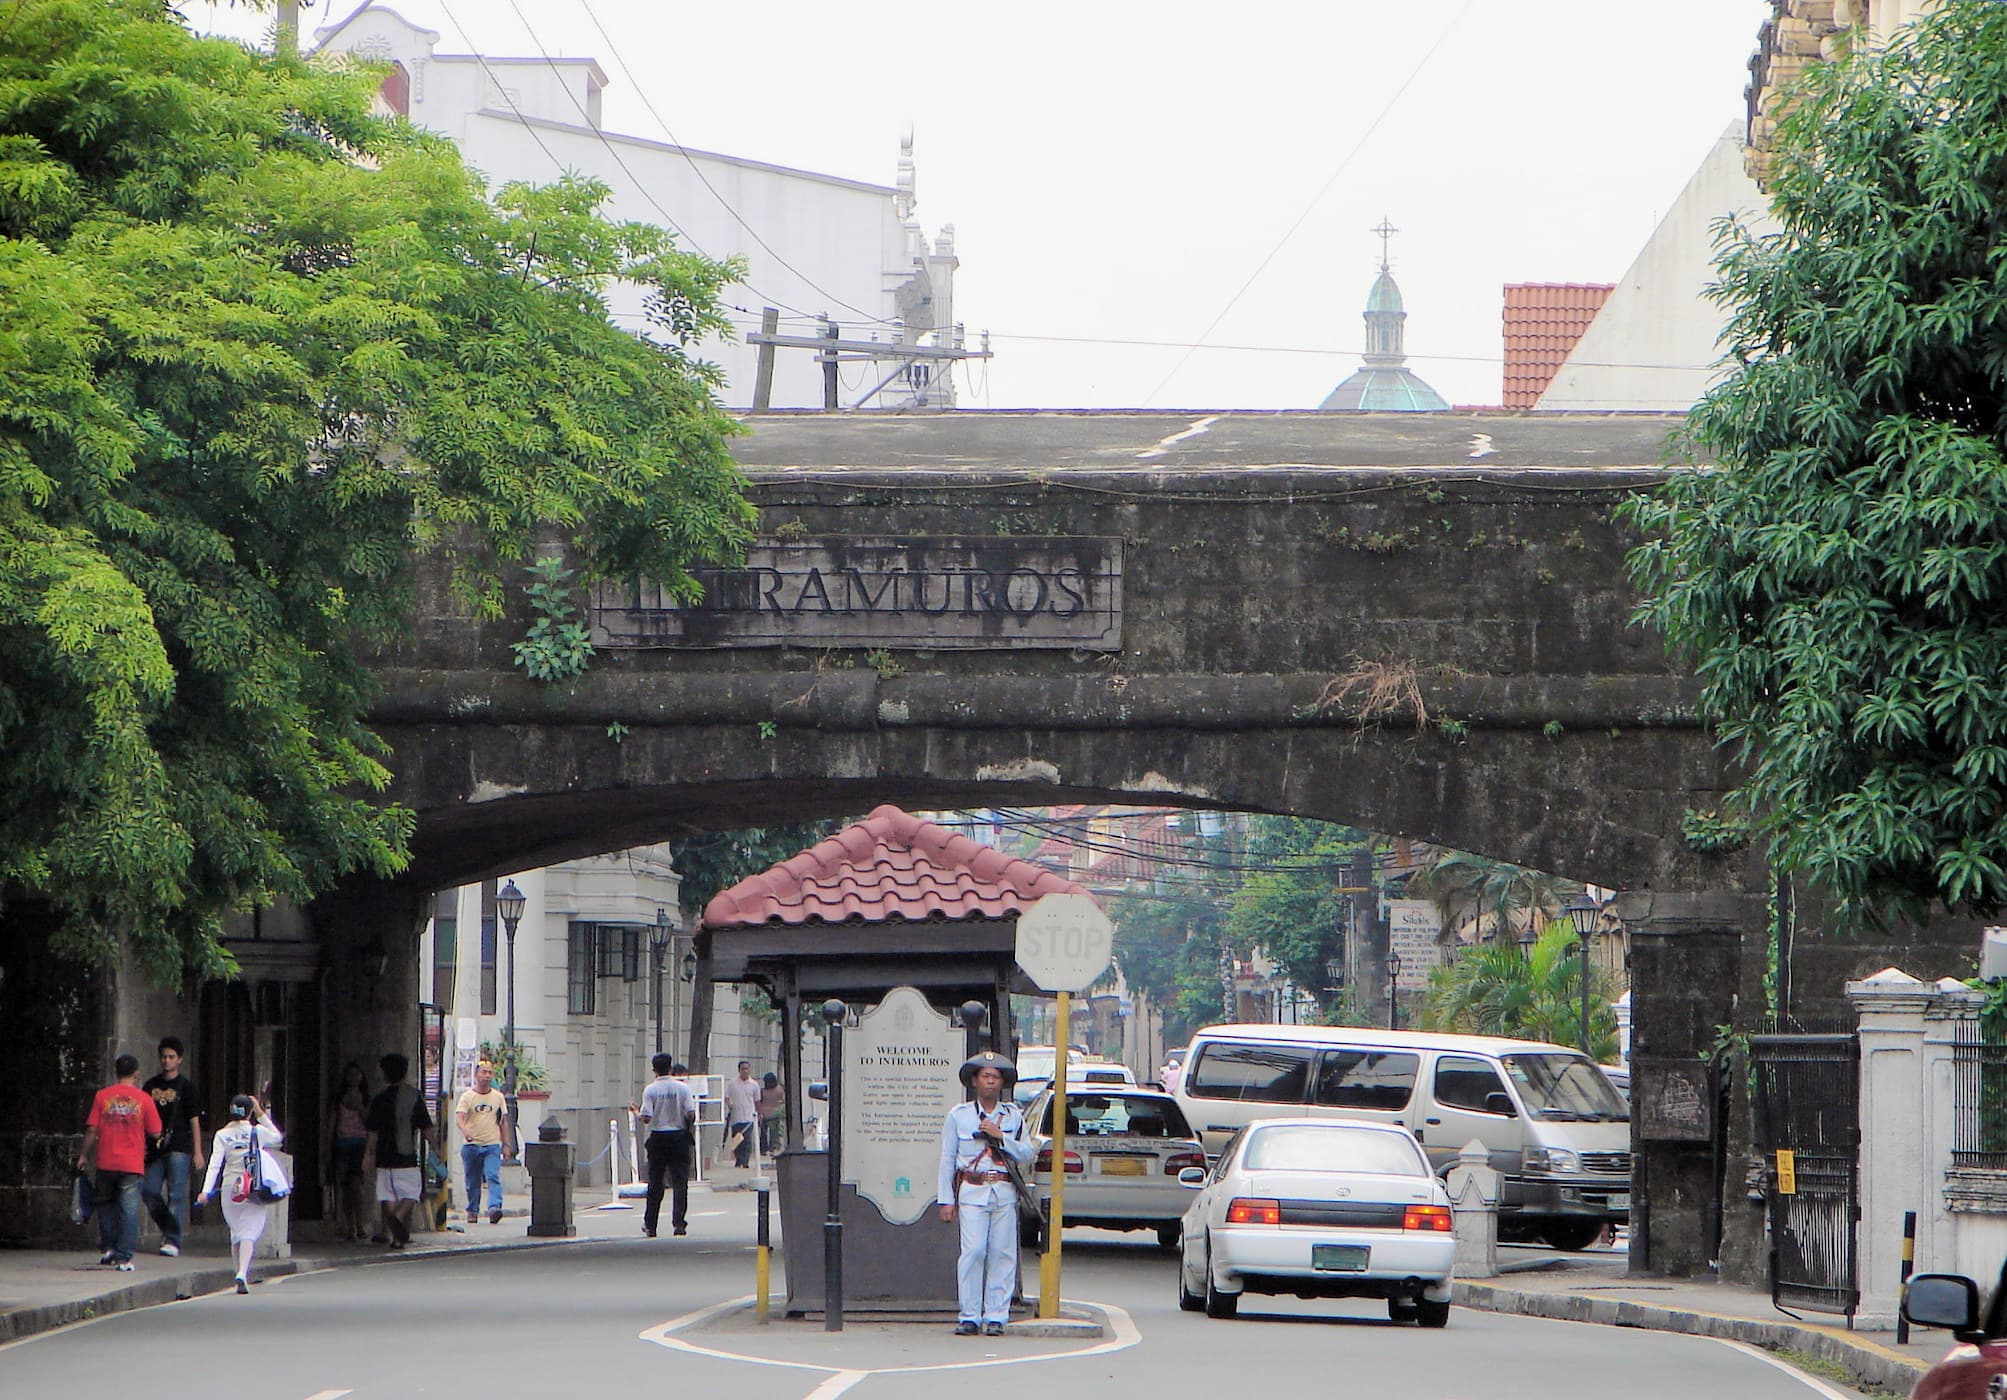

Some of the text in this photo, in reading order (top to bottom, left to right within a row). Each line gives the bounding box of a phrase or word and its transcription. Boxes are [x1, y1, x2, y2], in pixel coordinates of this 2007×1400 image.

[1024, 925, 1104, 960] STOP
[877, 1046, 932, 1055] WELCOME
[860, 1057, 950, 1066] TO INTRAMUROS
